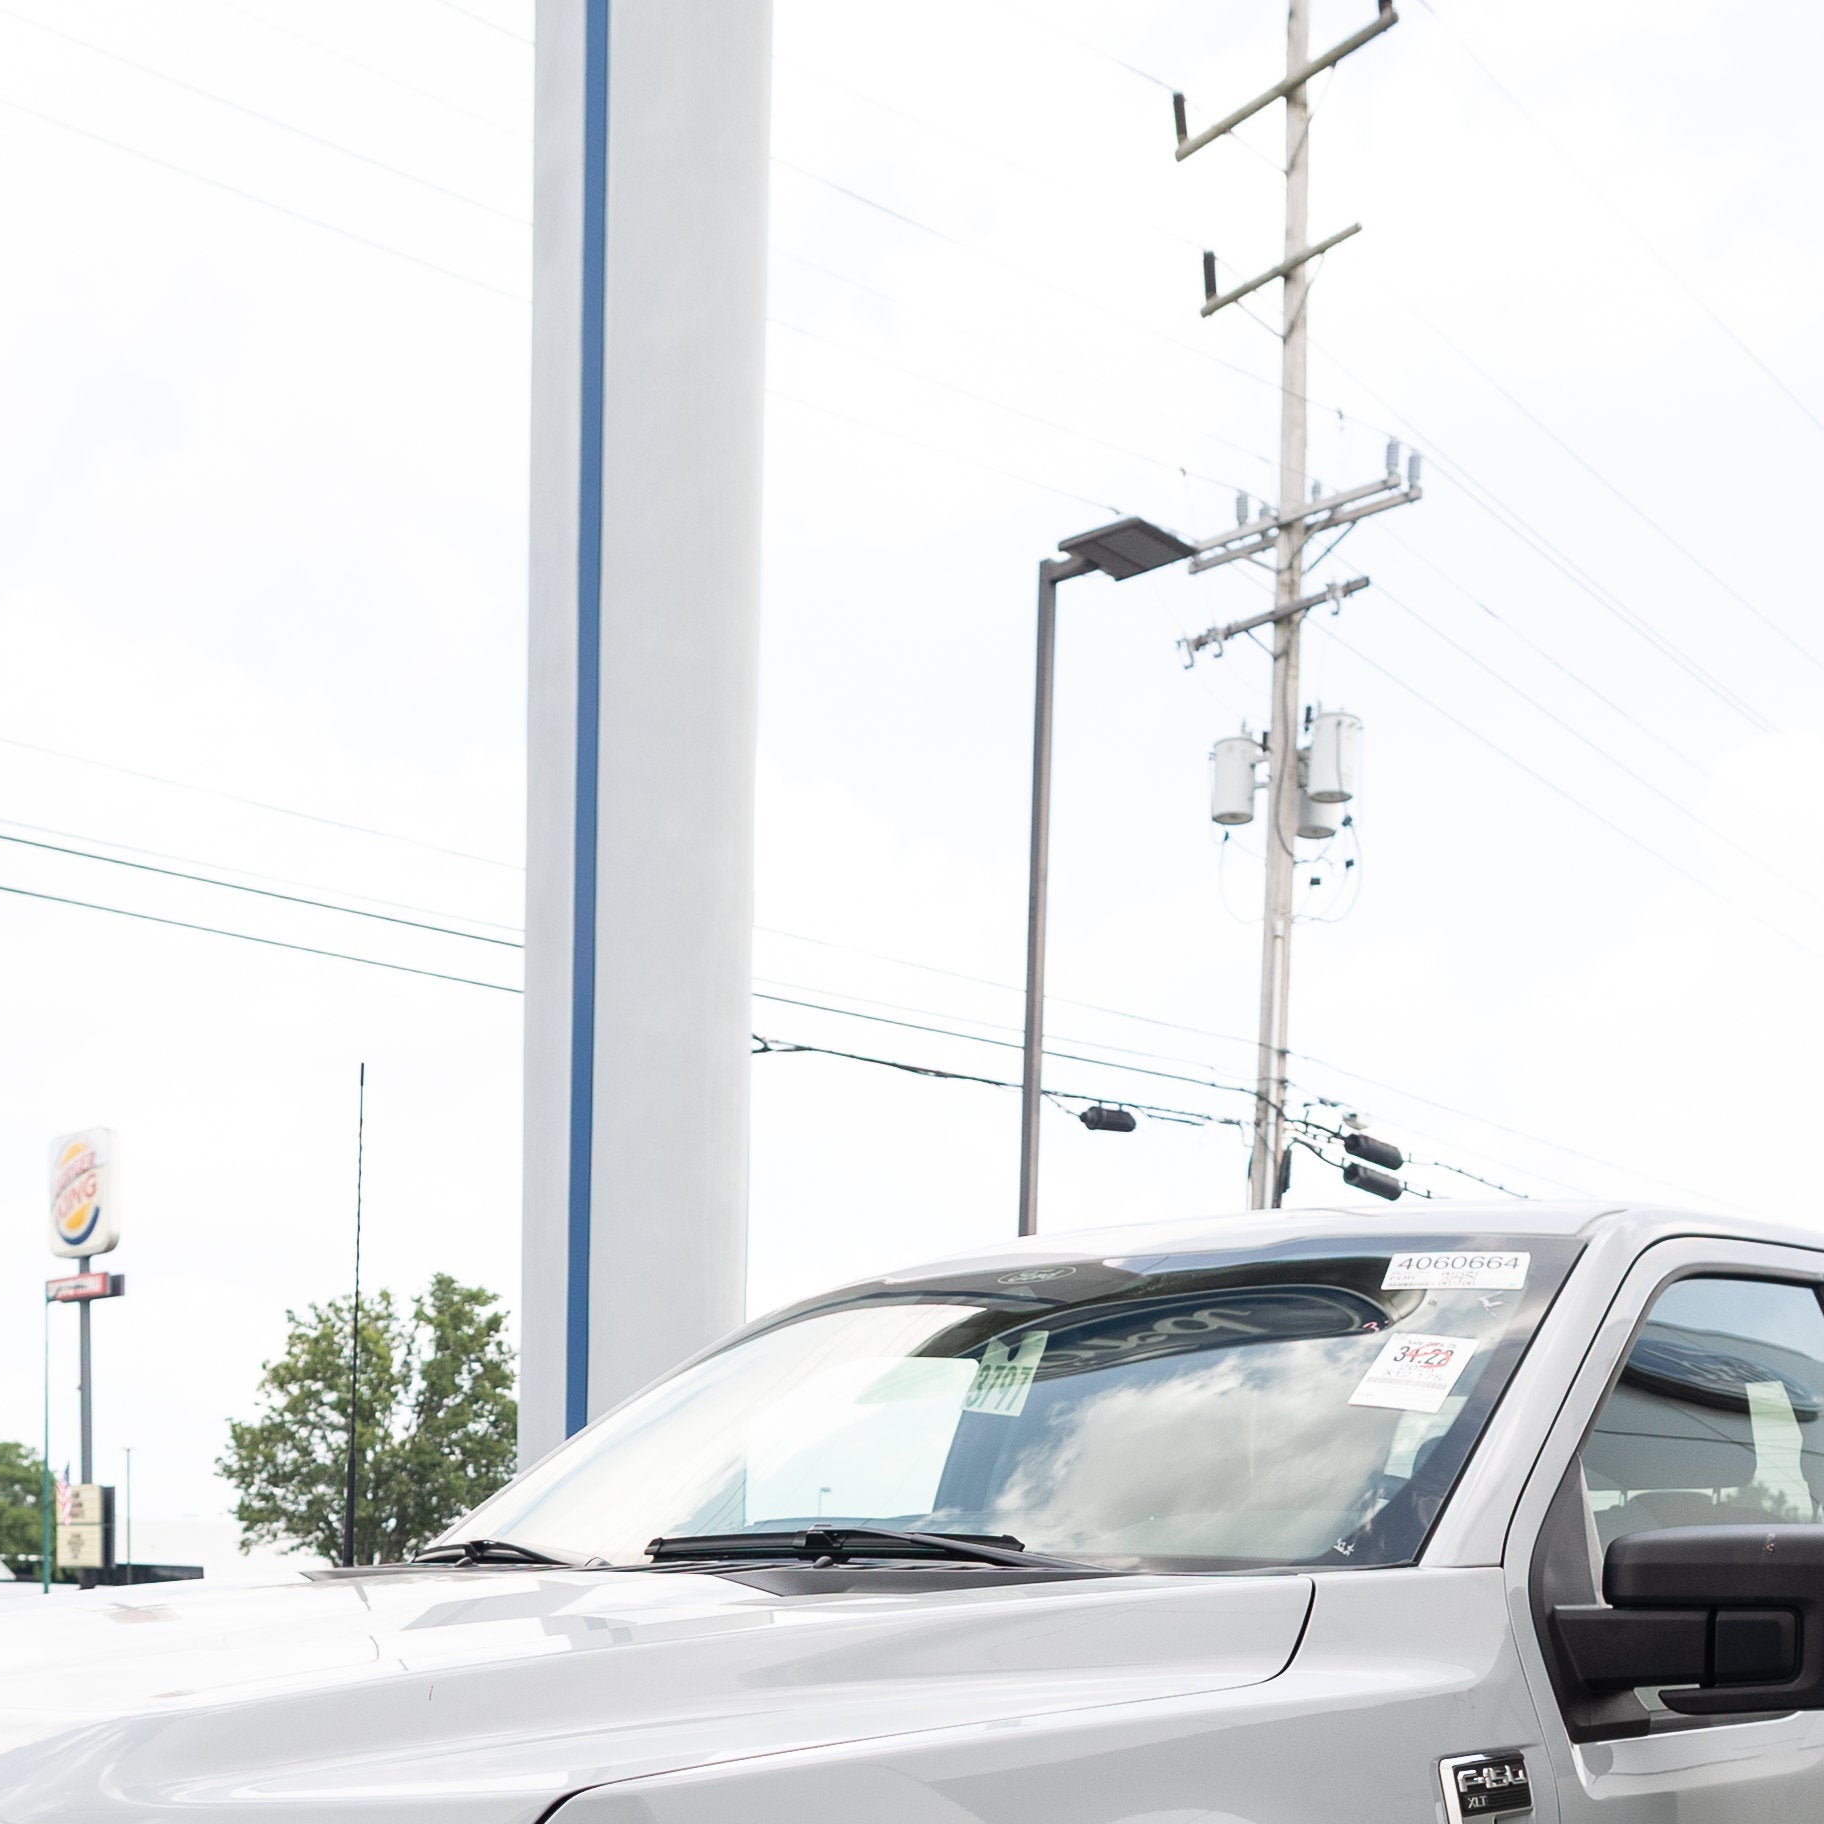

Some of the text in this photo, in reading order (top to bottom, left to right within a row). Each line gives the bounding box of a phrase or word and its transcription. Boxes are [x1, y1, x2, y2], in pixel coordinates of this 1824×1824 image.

[1397, 1255, 1520, 1271] 4060664
[1457, 1764, 1528, 1793] F-150
[1466, 1795, 1488, 1809] XLT
